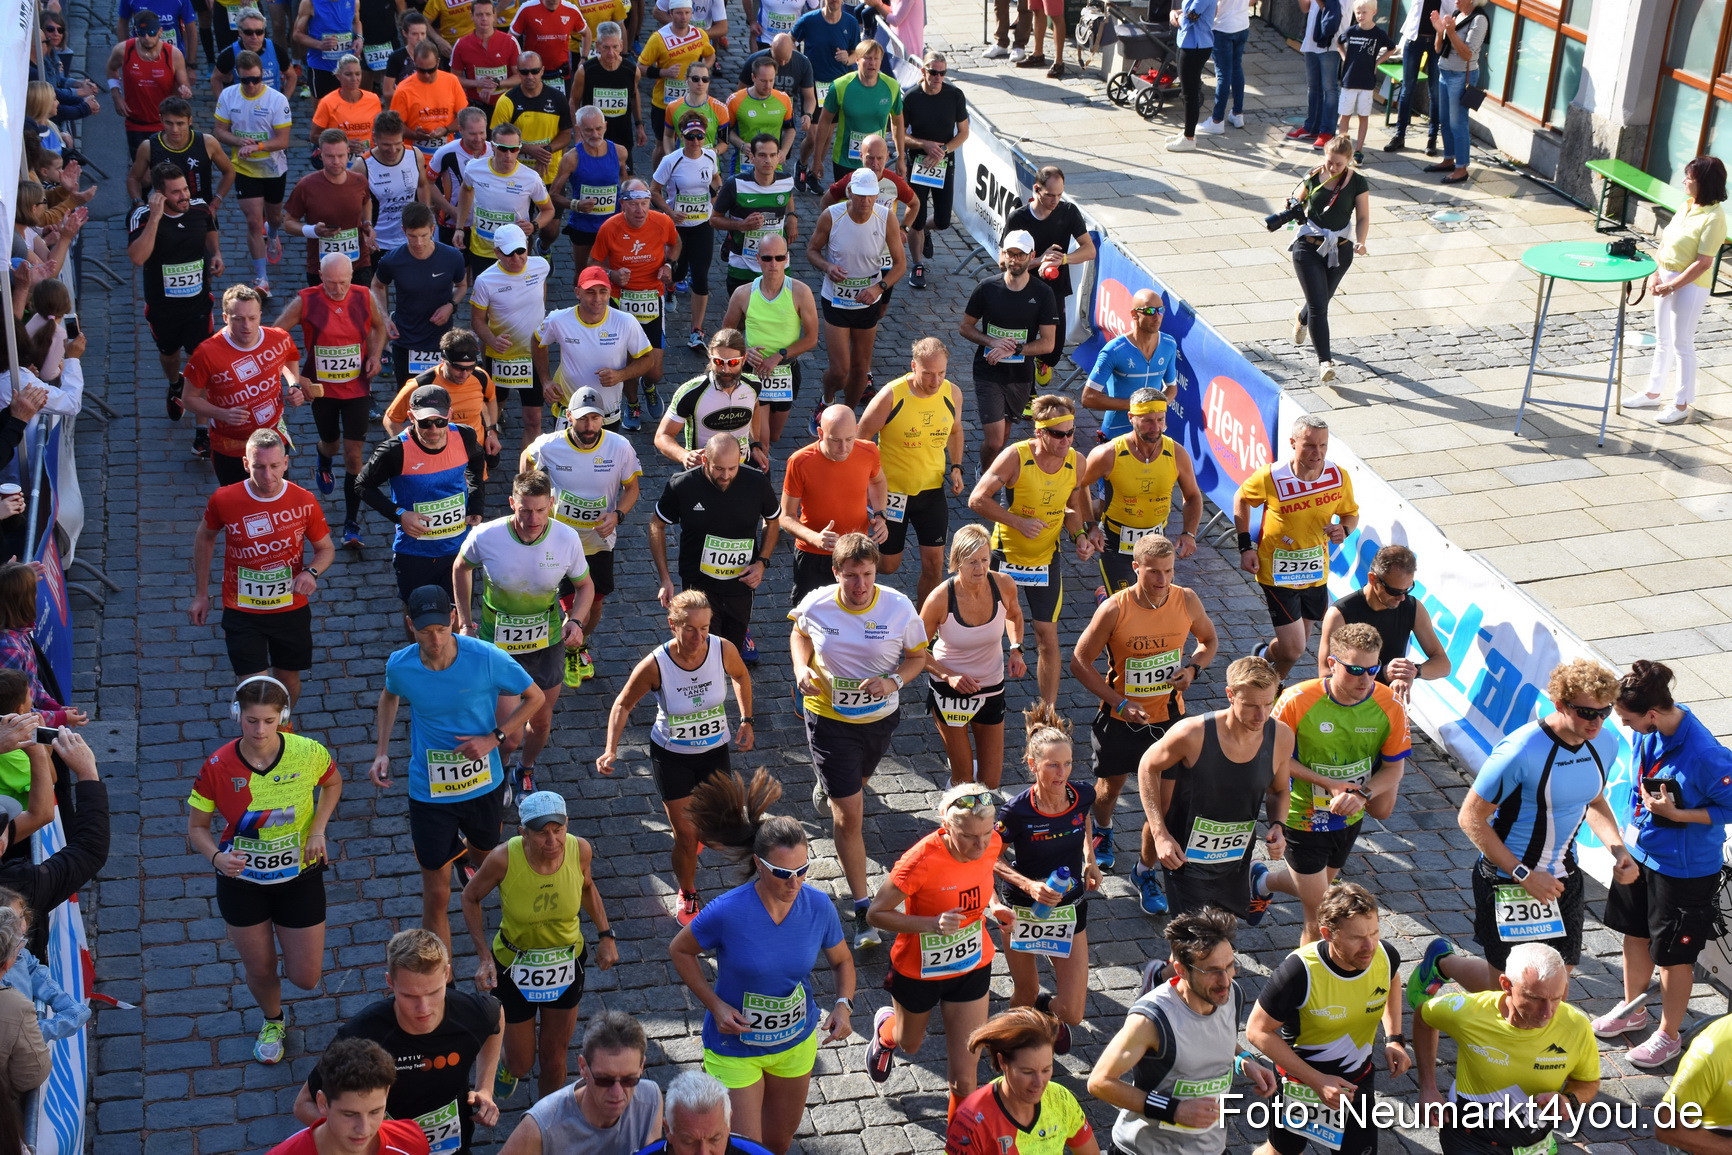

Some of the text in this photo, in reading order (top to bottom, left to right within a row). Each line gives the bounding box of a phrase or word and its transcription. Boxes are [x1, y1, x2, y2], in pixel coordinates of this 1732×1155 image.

[770, 20, 792, 30] 2531
[668, 41, 705, 58] MAX BÖGL
[597, 98, 624, 108] 1126
[916, 164, 942, 178] 2792
[478, 209, 513, 222] BOCK
[679, 204, 706, 214] 1042
[324, 241, 356, 253] 2314
[169, 273, 202, 287] 2521
[624, 302, 656, 313] 1010
[990, 326, 1025, 341] BOCK
[317, 345, 361, 358] BOCK
[321, 357, 357, 371] 1224
[496, 364, 529, 377] 1028
[327, 372, 351, 380] PETER
[494, 376, 529, 385] CHRISTOPH
[718, 411, 746, 421] RADAU
[1207, 381, 1269, 472] Hervis
[1213, 438, 1239, 470] SPORTS
[417, 495, 463, 513] BOCK
[561, 491, 605, 509] BOCK
[1280, 490, 1343, 515] MAX BÖGL
[563, 504, 602, 521] 1363
[708, 535, 754, 551] BOCK
[709, 551, 746, 566] 1048
[1273, 547, 1320, 560] BOCK
[714, 568, 735, 576] SVEN
[1278, 559, 1318, 573] 2376
[242, 569, 288, 582] BOCK
[1280, 573, 1316, 581] MICHAEL
[244, 582, 287, 597] 1173
[250, 598, 281, 606] TOBIAS
[500, 614, 548, 627] BOCK
[865, 621, 876, 630] 20
[502, 625, 545, 642] 1217
[506, 642, 538, 651] OLIVER
[1133, 638, 1169, 651] OEXL
[1128, 652, 1178, 670] BOCK
[1132, 665, 1176, 684] 1192
[684, 687, 709, 697] LANGE
[939, 695, 981, 712] 1107
[672, 705, 724, 723] BOCK
[946, 713, 970, 722] HEIDI
[676, 720, 722, 738] 2183
[689, 739, 709, 747] EVA
[436, 759, 484, 781] 1160
[1315, 761, 1367, 780] BOCK
[444, 777, 479, 792] OLIVER
[1198, 821, 1250, 835] BOCK
[239, 837, 295, 853] BOCK
[1195, 834, 1243, 850] 2156
[243, 851, 293, 870] 2686
[1203, 850, 1229, 860] JÖRG
[532, 891, 560, 913] CIS
[1503, 903, 1553, 923] 2303
[1018, 922, 1067, 940] 2023
[1509, 923, 1553, 935] MARKUS
[930, 936, 978, 966] 2785
[1025, 940, 1059, 951] GISELA
[518, 964, 569, 987] 2627
[528, 989, 560, 1000] EDITH
[749, 988, 803, 1012] BOCK
[749, 1007, 802, 1030] 2635
[754, 1026, 798, 1042] SIBYLLE
[397, 1054, 421, 1062] APTIV
[413, 1063, 427, 1071] Team
[1533, 1063, 1567, 1071] Runners
